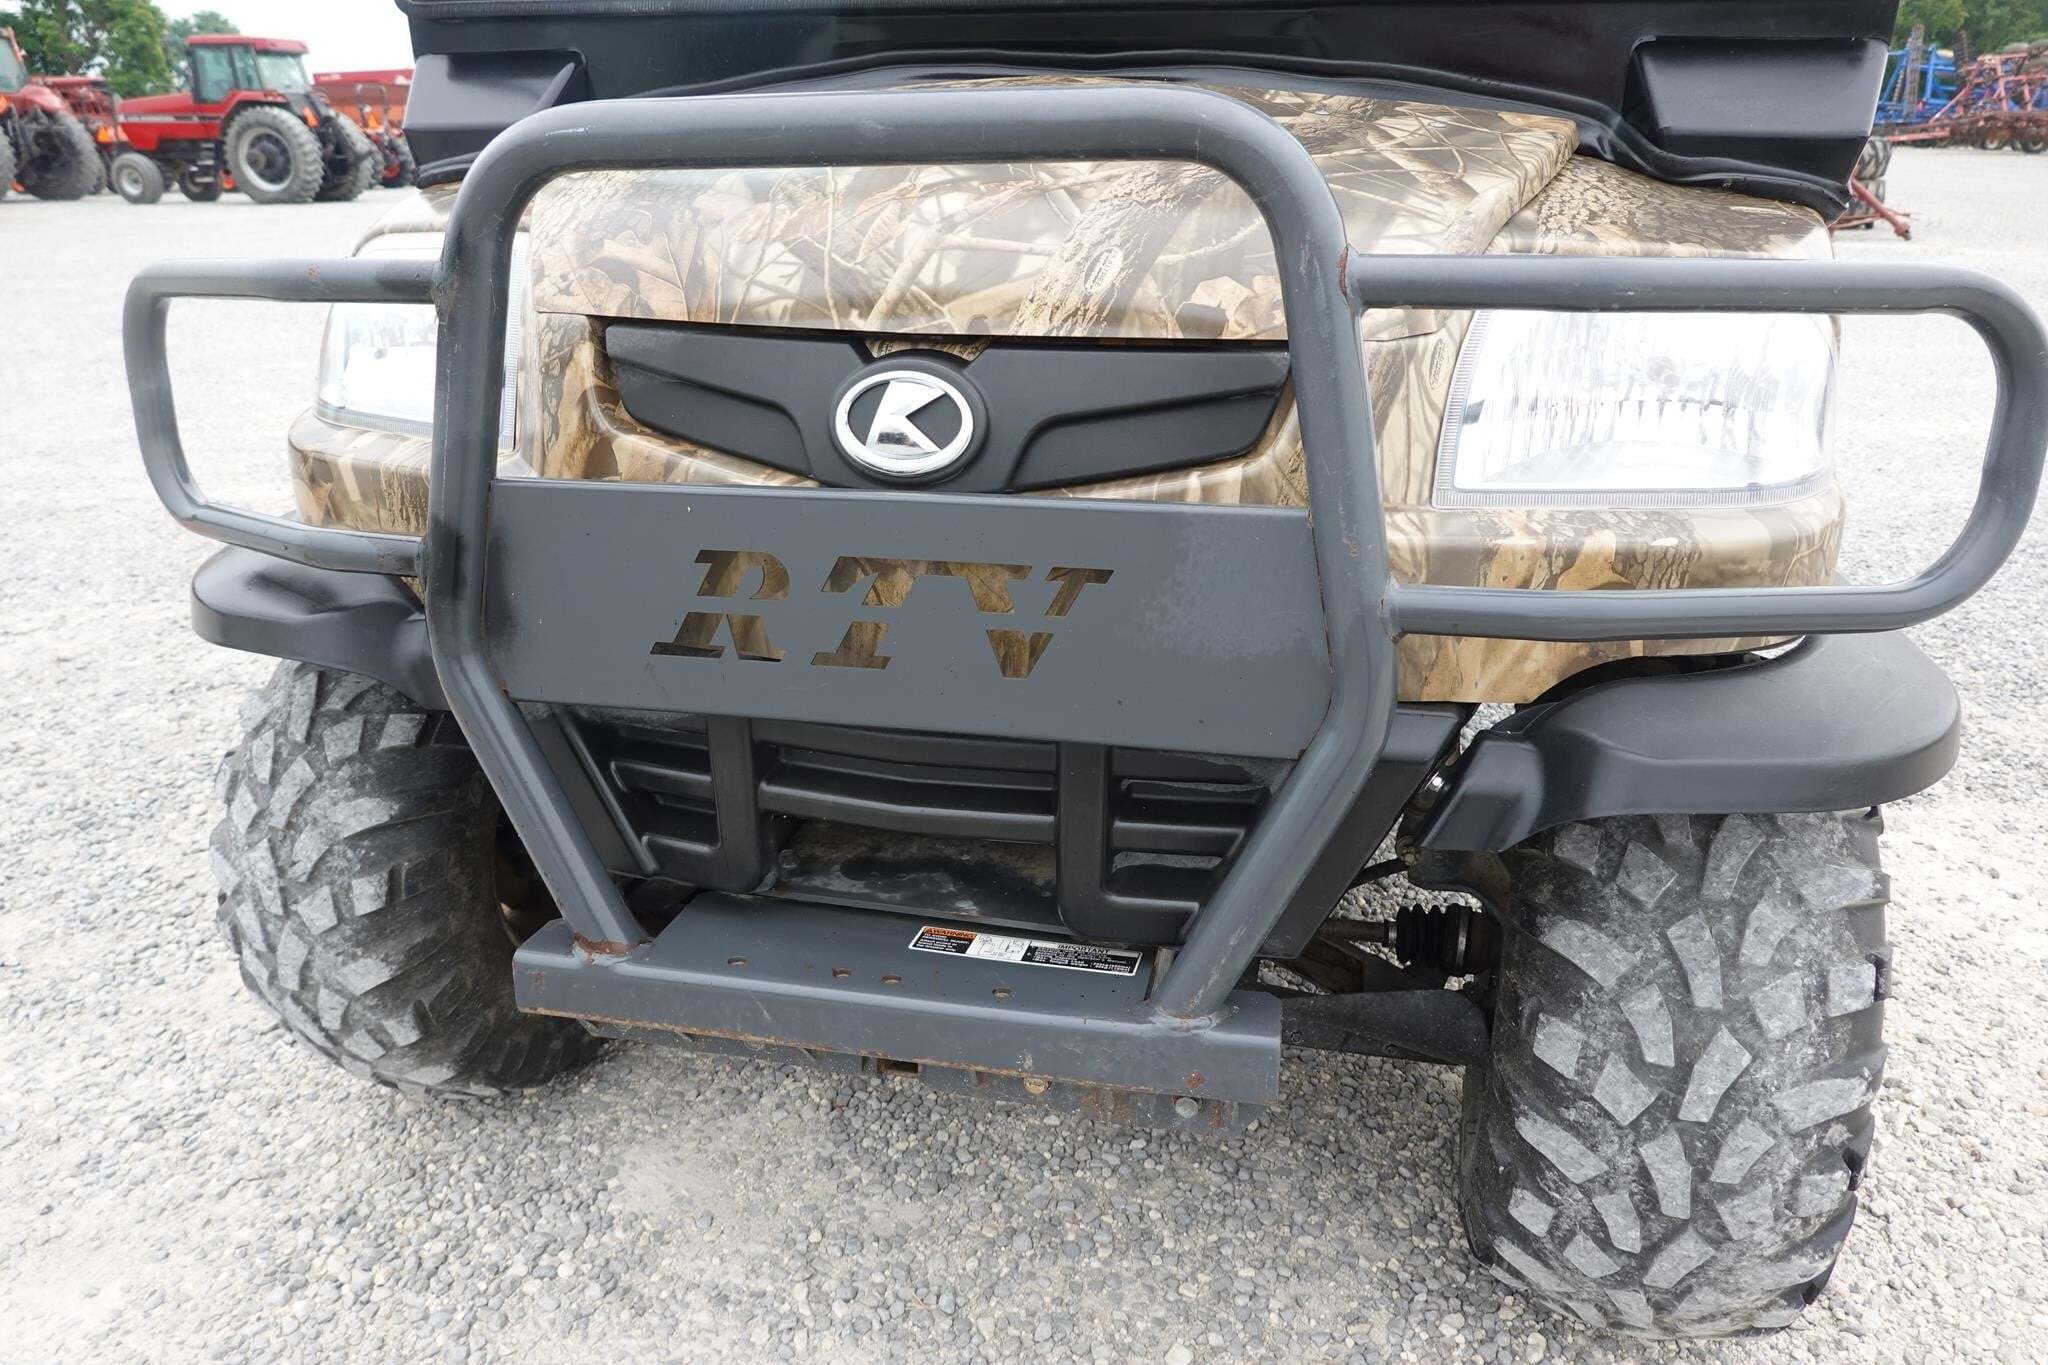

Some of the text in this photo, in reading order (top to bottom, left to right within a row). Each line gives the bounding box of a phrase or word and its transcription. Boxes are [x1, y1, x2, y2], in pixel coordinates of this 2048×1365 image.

[650, 549, 1115, 679] RTV
[932, 928, 977, 939] WARNING
[1058, 944, 1112, 955] IMPORTANT
